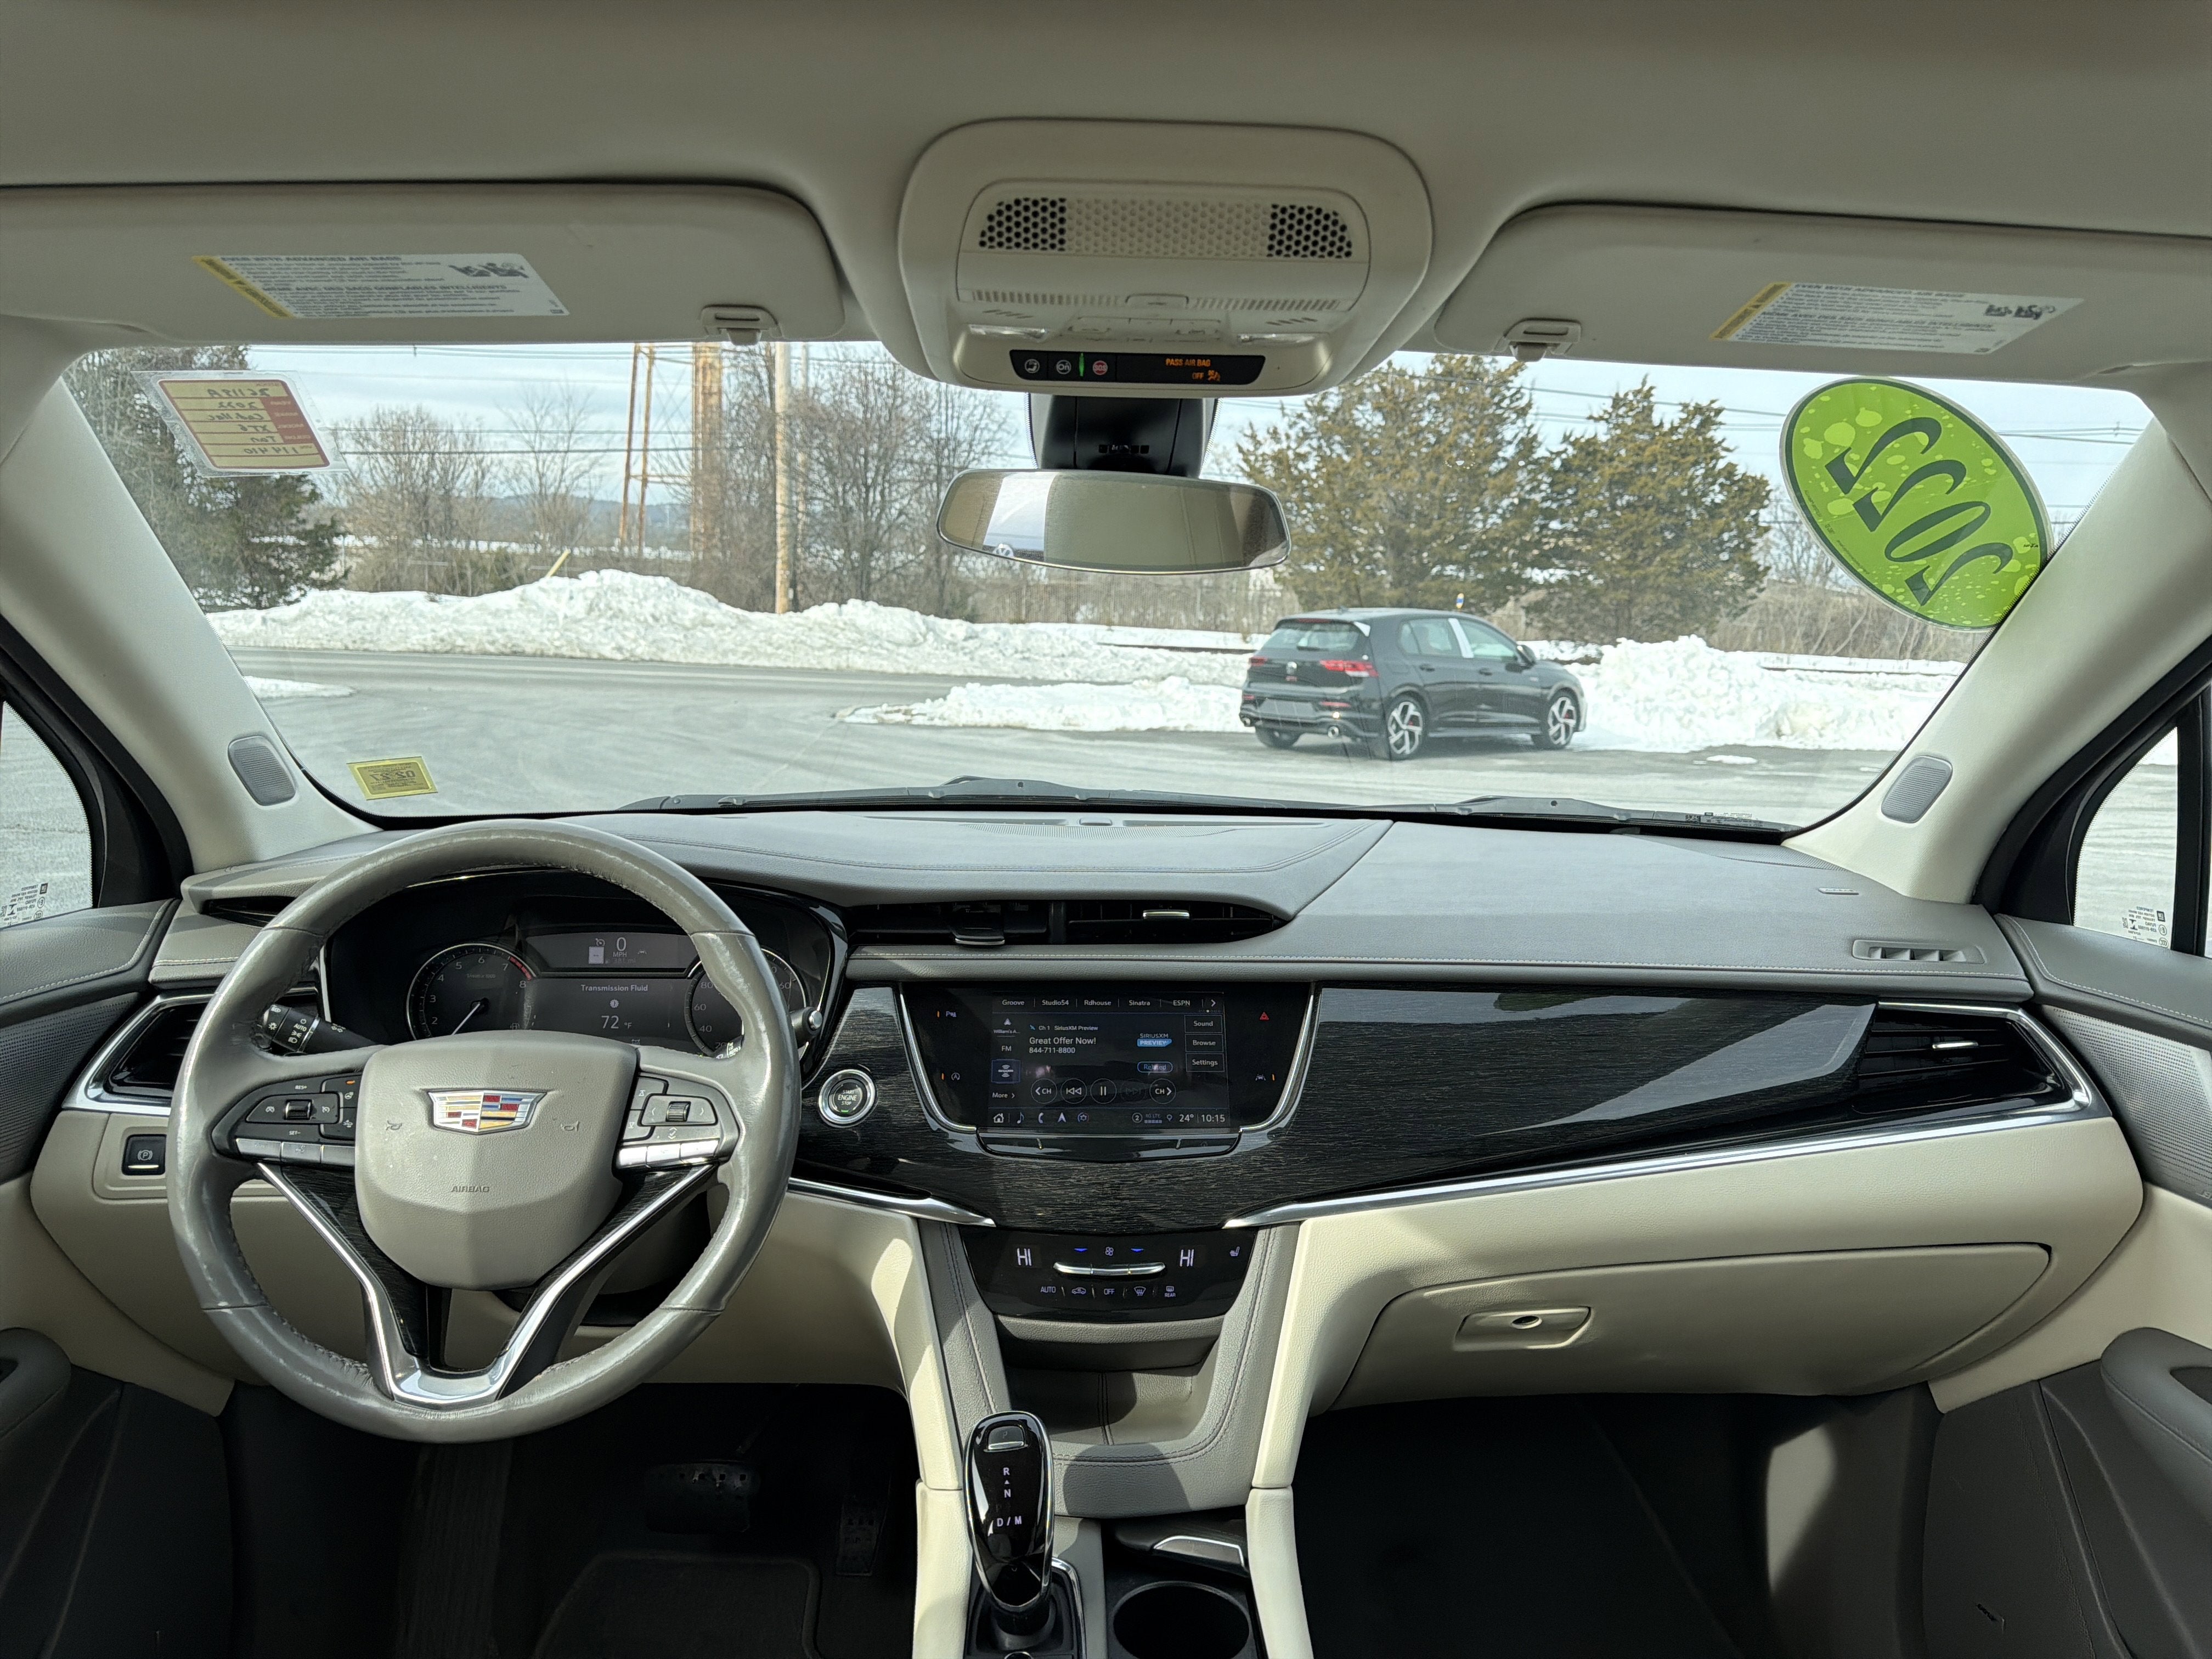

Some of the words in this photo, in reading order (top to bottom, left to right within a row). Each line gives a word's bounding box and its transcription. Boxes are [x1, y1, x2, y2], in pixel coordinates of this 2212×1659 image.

[1165, 358, 1183, 366] PASS
[616, 937, 627, 951] 0
[437, 974, 444, 982] 4
[519, 980, 527, 988] 8
[430, 995, 436, 1003] 3
[431, 1017, 438, 1025] 2
[601, 1015, 619, 1029] 72
[294, 1023, 307, 1032] AUTO
[1192, 1059, 1218, 1067] Settings
[1179, 1114, 1194, 1122] 24°
[1201, 1114, 1226, 1122] 10:15
[1017, 1248, 1032, 1266] HI
[1180, 1249, 1194, 1267] HI
[1003, 1467, 1011, 1476] R
[1004, 1489, 1011, 1498] N
[996, 1517, 1003, 1527] D
[1014, 1515, 1022, 1525] M
